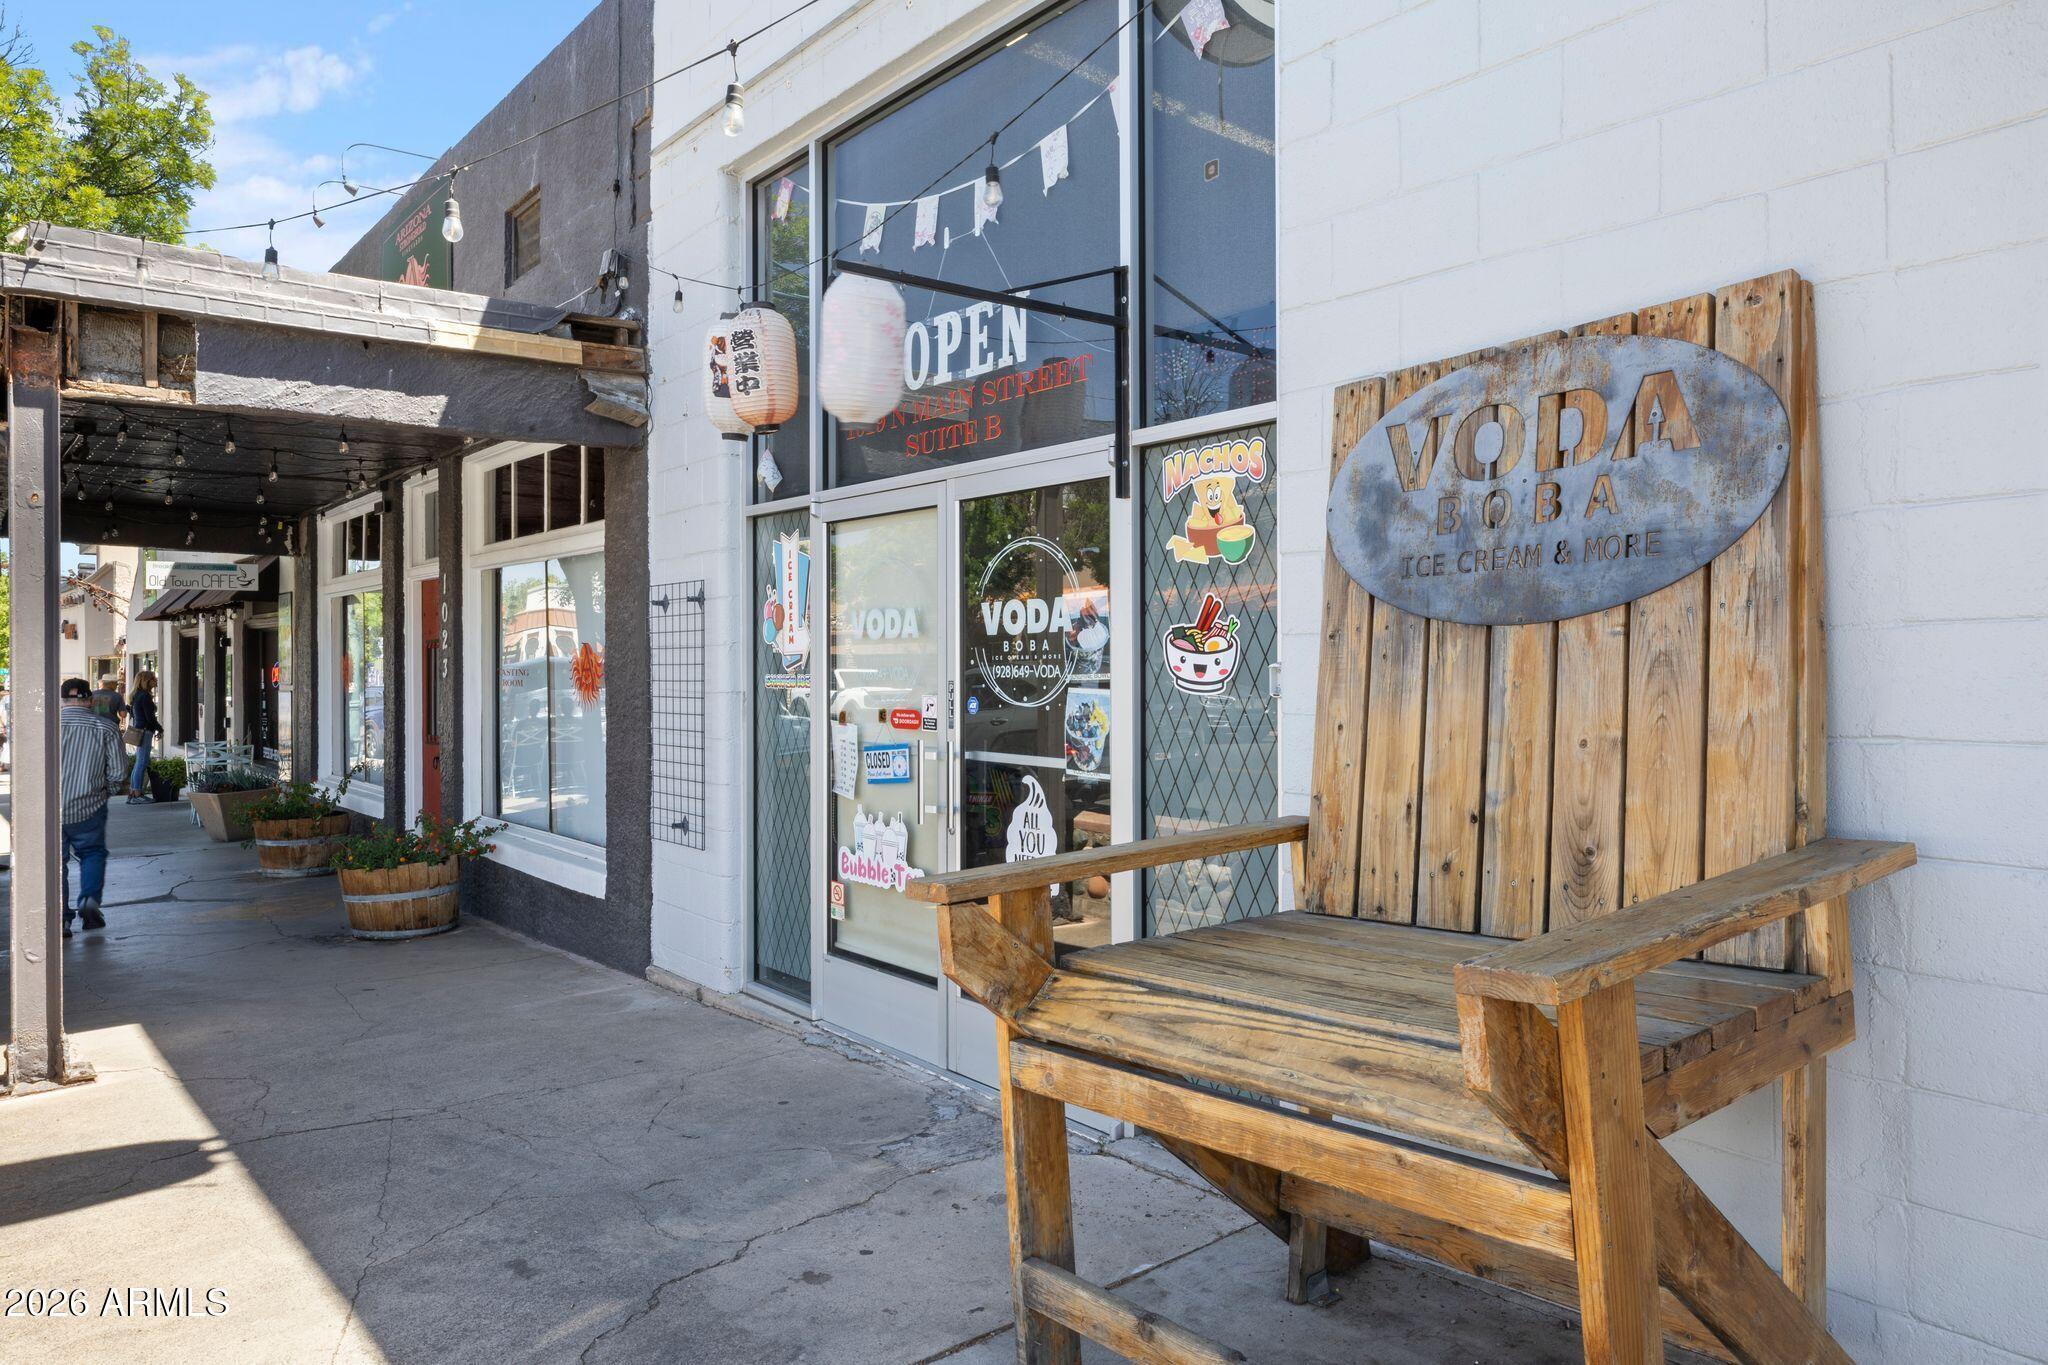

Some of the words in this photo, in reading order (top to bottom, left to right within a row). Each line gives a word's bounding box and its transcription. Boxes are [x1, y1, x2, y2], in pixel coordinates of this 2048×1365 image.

[395, 203, 432, 246] ARIZONA
[904, 289, 1030, 391] OPEN
[889, 403, 907, 429] N
[912, 385, 975, 424] MAIN
[982, 353, 1093, 407] STREET
[905, 419, 978, 458] SUITE
[984, 414, 1002, 442] B
[1386, 369, 1701, 493] VODA
[1164, 438, 1265, 502] NACHOS
[1436, 474, 1620, 537] BOBA
[1401, 552, 1445, 580] ICE
[1456, 543, 1542, 573] CREAM
[1553, 539, 1572, 566] &
[1583, 530, 1664, 564] MORE
[149, 574, 167, 588] Old
[169, 575, 200, 588] Town
[201, 573, 238, 589] CAFE
[440, 573, 449, 679] 1023
[851, 607, 920, 640] VODA
[981, 596, 1074, 636] VODA
[1003, 639, 1050, 653] BOBA
[497, 668, 529, 677] ASTING
[992, 664, 1062, 679] (928)649-VODA
[865, 751, 891, 770] CLOSED
[1023, 811, 1041, 830] ALL
[1018, 830, 1045, 855] YOU
[841, 851, 889, 885] Bubble
